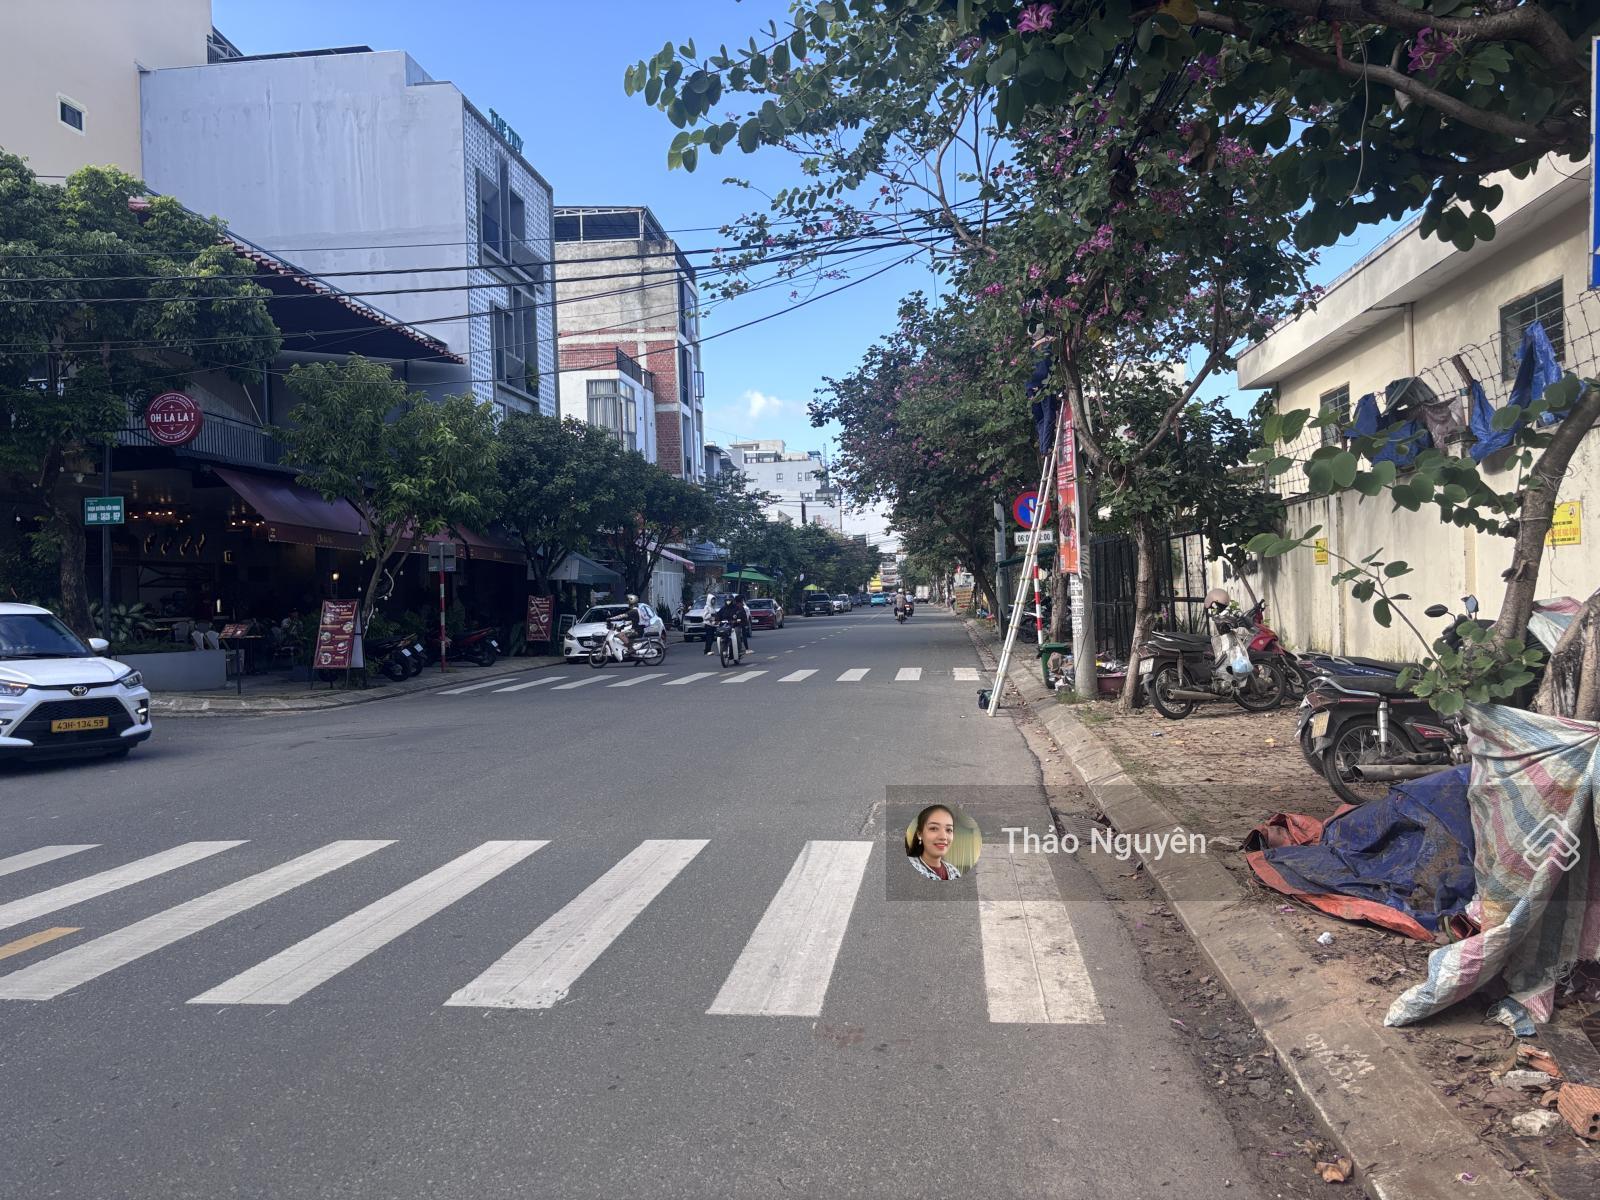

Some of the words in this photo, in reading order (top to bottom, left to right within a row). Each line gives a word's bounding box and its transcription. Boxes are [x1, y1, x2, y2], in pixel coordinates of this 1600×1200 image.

[150, 413, 162, 423] OH
[164, 413, 175, 422] LA
[178, 412, 189, 422] LA
